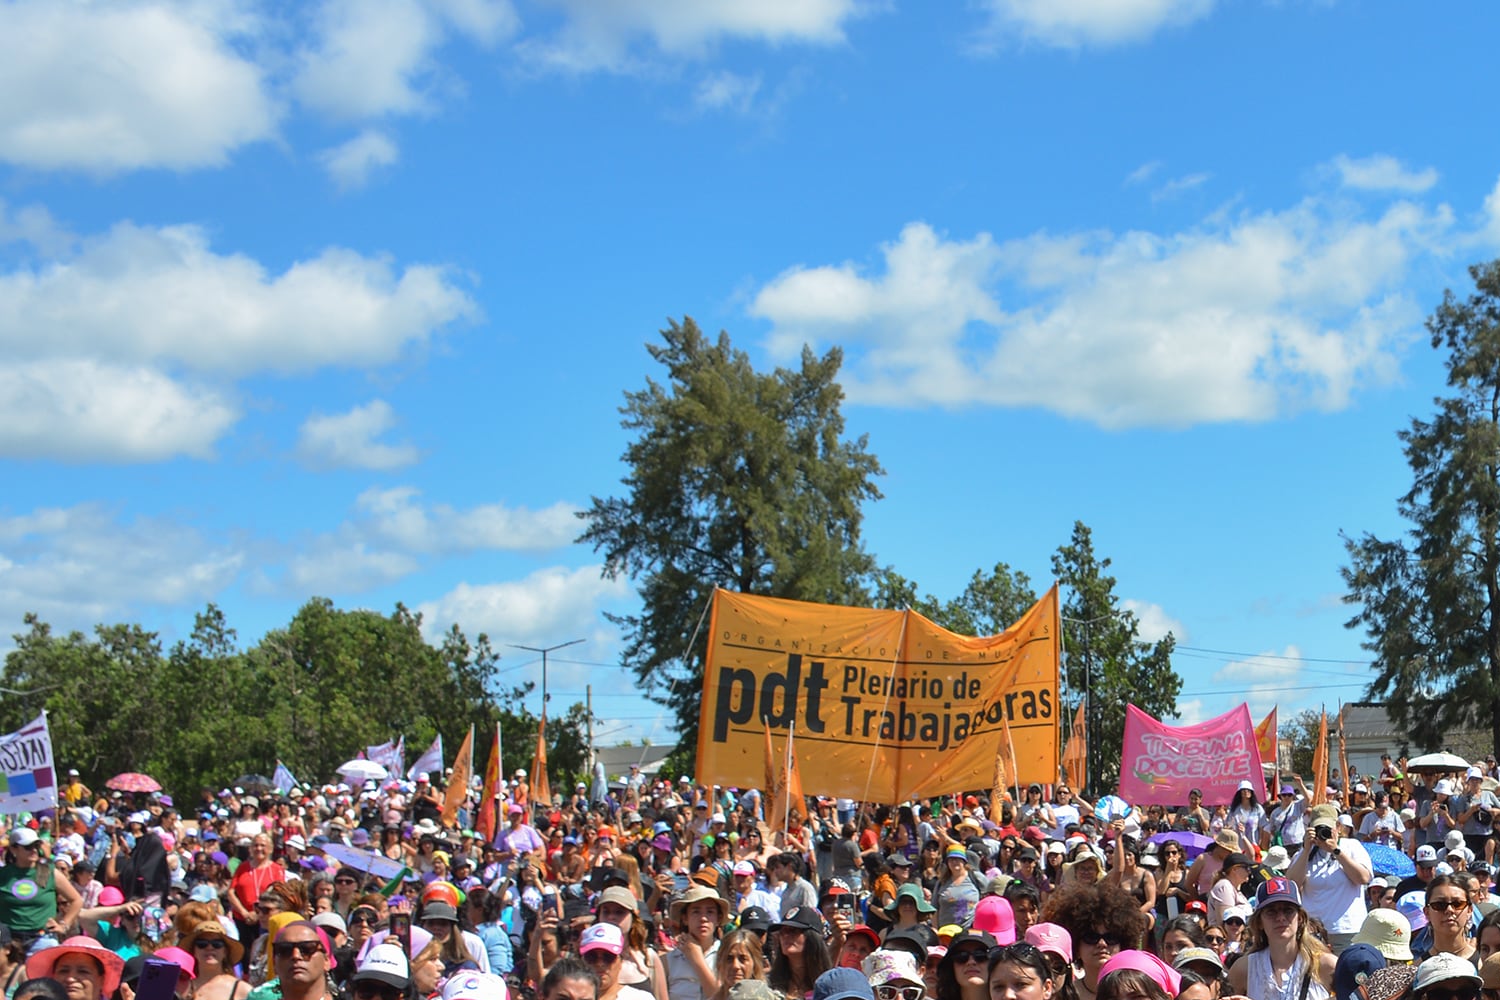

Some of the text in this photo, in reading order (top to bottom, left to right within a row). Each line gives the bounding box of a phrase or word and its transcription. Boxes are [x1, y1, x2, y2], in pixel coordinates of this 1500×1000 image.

[926, 650, 949, 660] DE
[713, 653, 829, 743] pdt
[843, 665, 981, 700] Plenario de
[841, 688, 1051, 751] Trabajadoras
[1140, 731, 1246, 758] TRIBUNA
[1136, 751, 1251, 778] DOCENTE
